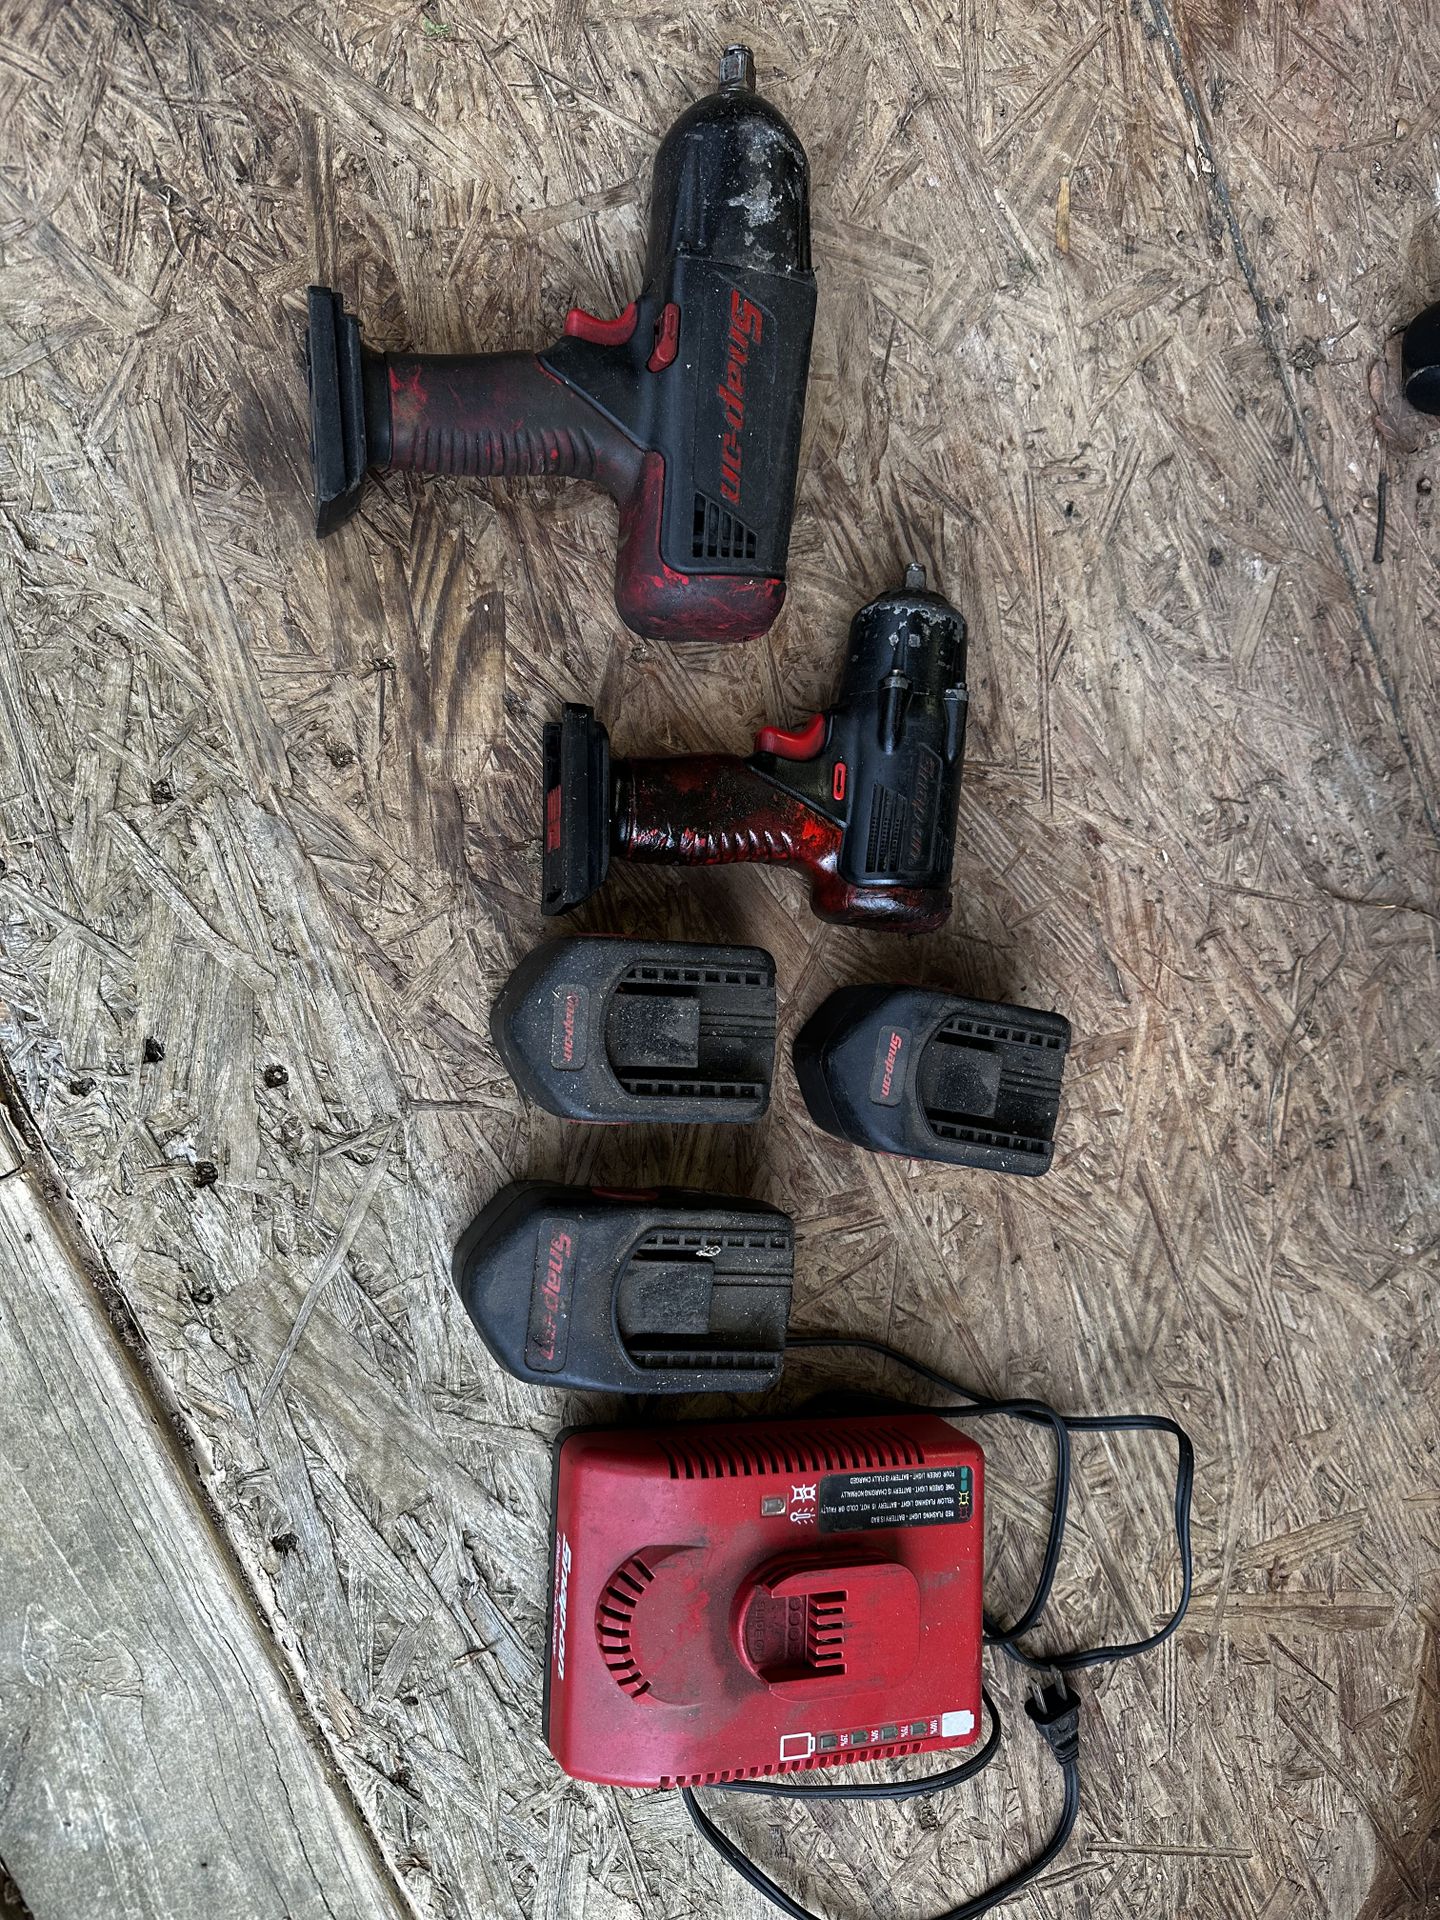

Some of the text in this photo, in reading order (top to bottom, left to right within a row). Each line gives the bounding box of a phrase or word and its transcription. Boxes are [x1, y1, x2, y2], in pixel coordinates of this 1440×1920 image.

[717, 288, 763, 506] Snap-on
[562, 991, 579, 1062] Snap-on
[881, 1031, 903, 1097] Snap-on
[872, 1475, 885, 1483] FULLY
[890, 1473, 909, 1482] BATTERY
[912, 1472, 926, 1480] LIGHT
[926, 1471, 942, 1479] GREEN
[943, 1470, 955, 1479] FOUR
[850, 1476, 872, 1485] CHARGED
[893, 1486, 912, 1495] BATTERY
[915, 1485, 928, 1493] LIGHT
[928, 1484, 944, 1492] GREEN
[945, 1483, 955, 1491] ONE
[841, 1490, 865, 1499] NORMALLY
[865, 1488, 887, 1497] CHARGING
[901, 1499, 914, 1508] LIGHT
[914, 1498, 936, 1507] FLASHING
[937, 1496, 955, 1505] YELLOW
[820, 1506, 837, 1514] FAULTY
[838, 1505, 846, 1513] OR
[846, 1504, 859, 1512] COLD
[878, 1501, 897, 1510] BATTERY
[885, 1513, 906, 1522] BATTERY
[909, 1512, 922, 1521] LIGHT
[922, 1511, 944, 1519] FLASHING
[945, 1510, 954, 1518] RED
[871, 1516, 880, 1524] BAD
[557, 1532, 572, 1681] Snap-on
[901, 1725, 909, 1738] 75%
[930, 1720, 938, 1735] 100%
[840, 1734, 848, 1747] 25%
[871, 1730, 879, 1743] 50%
